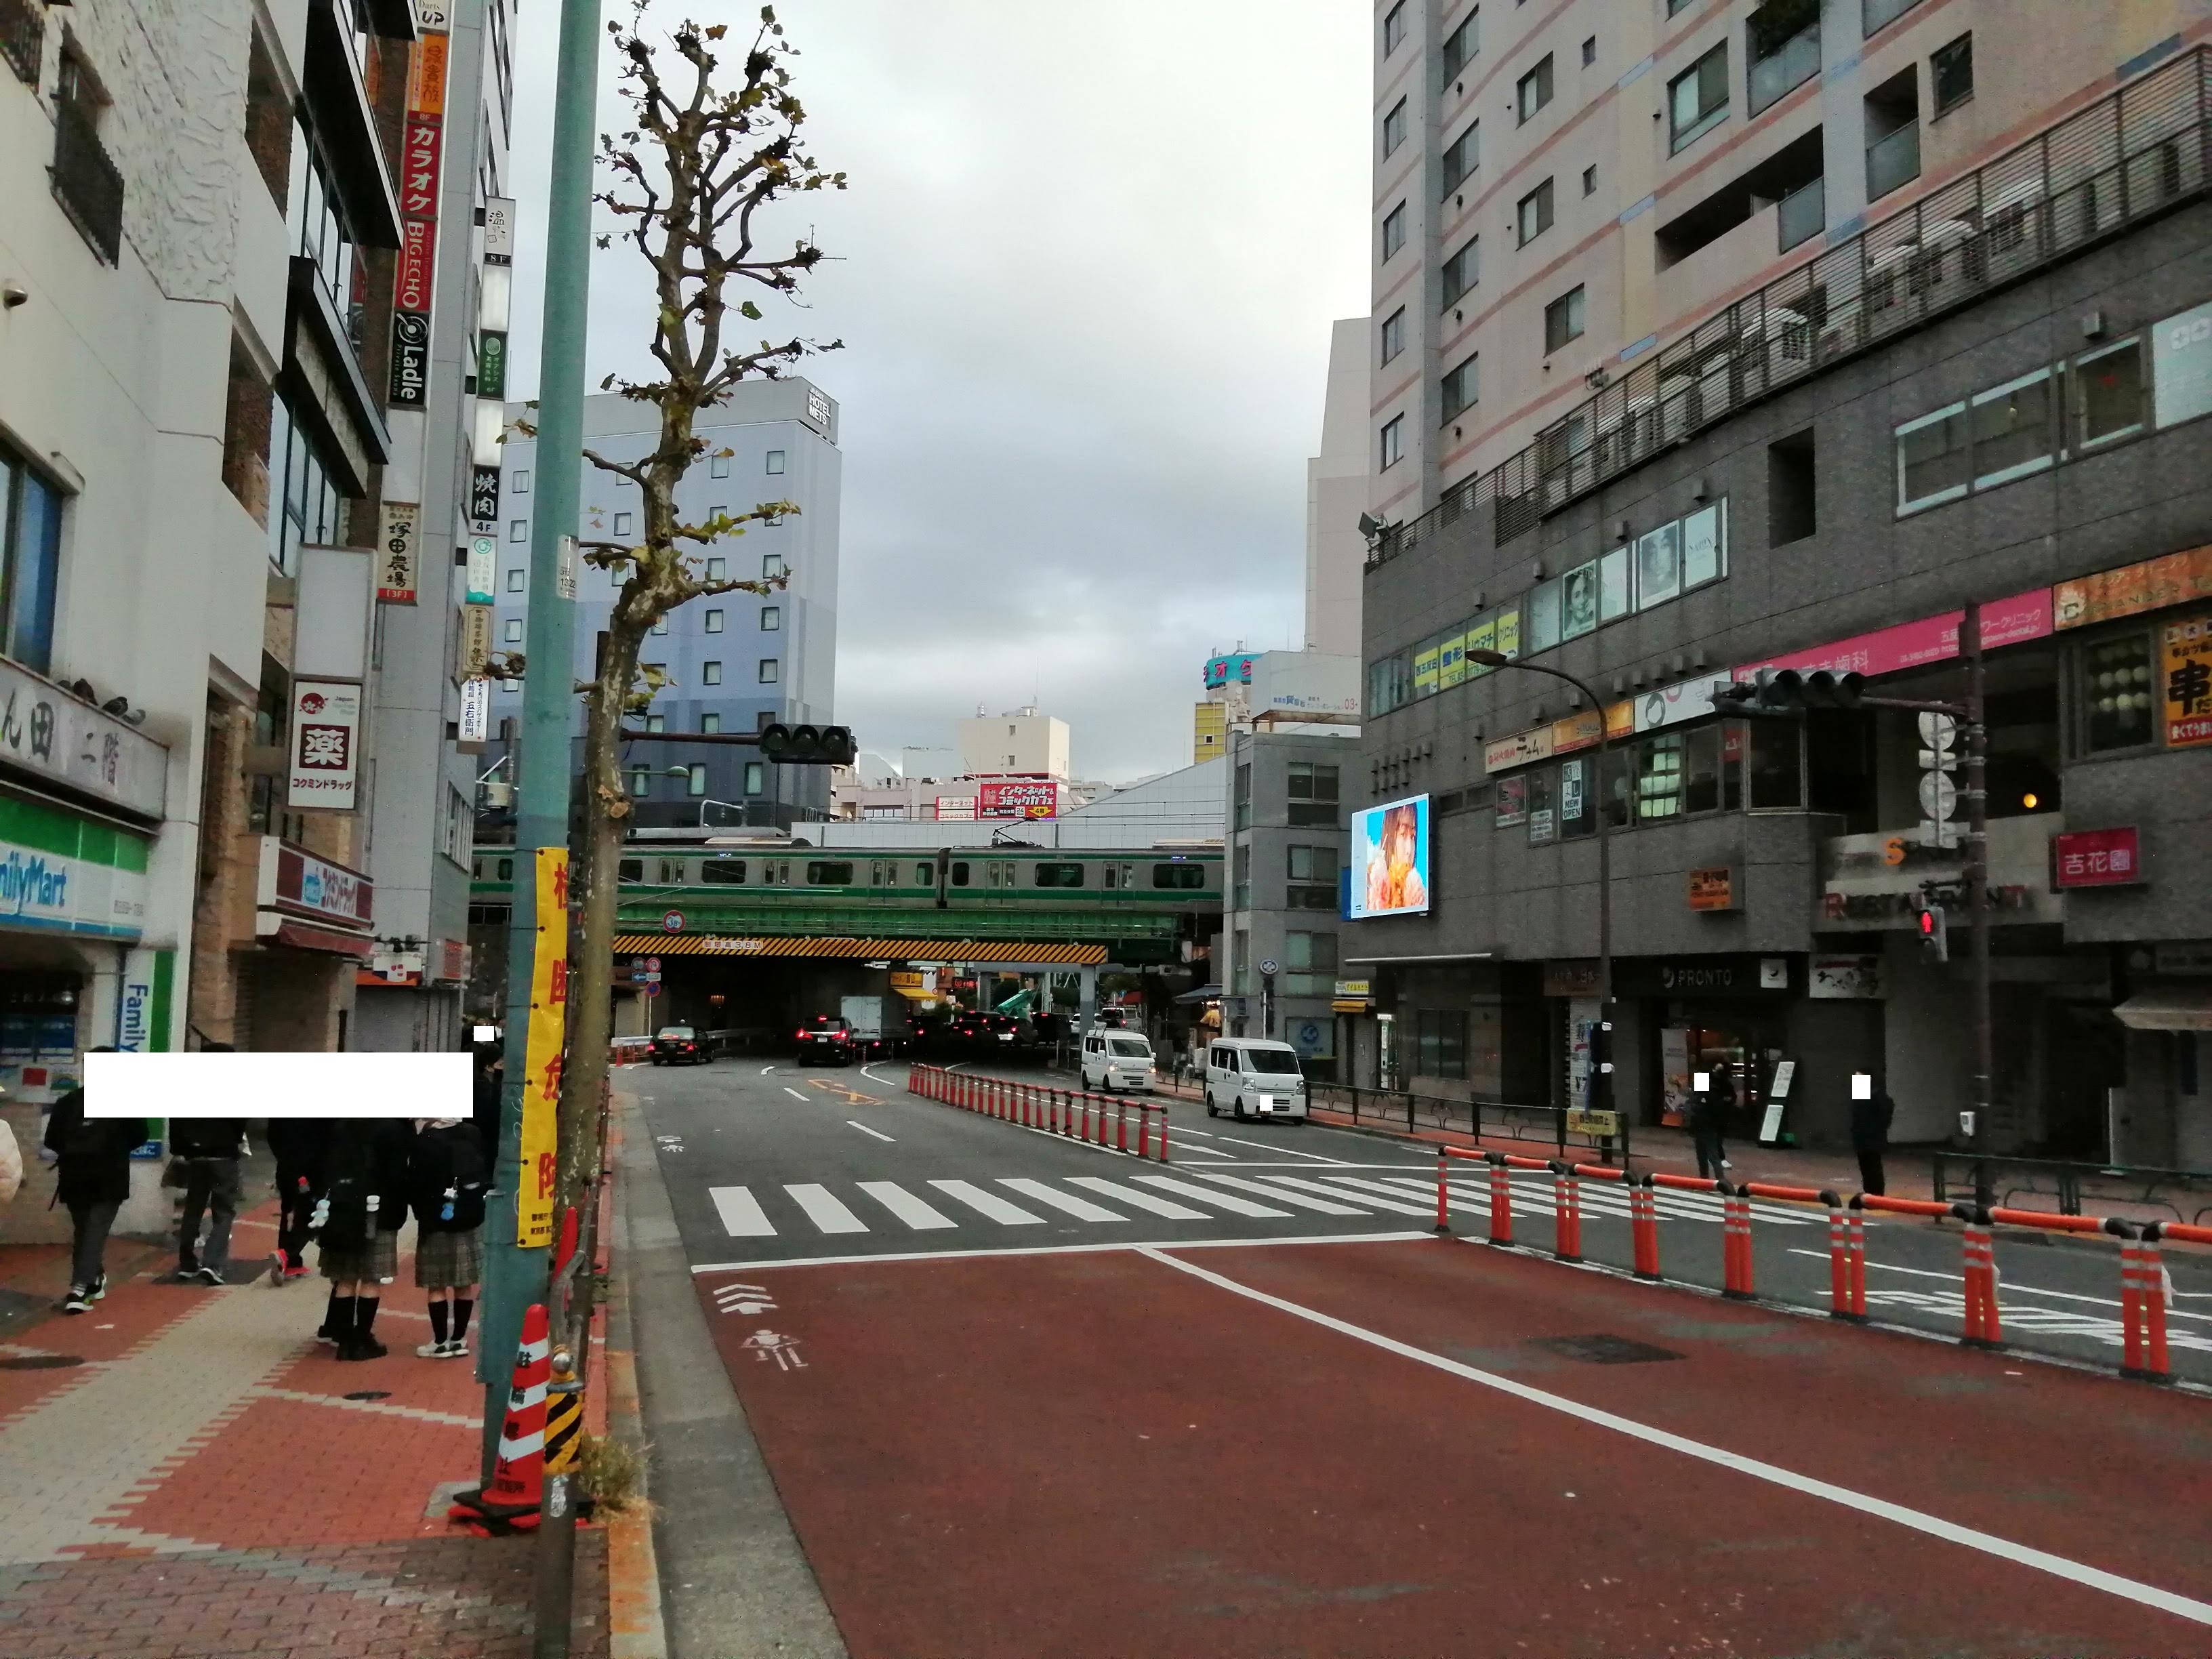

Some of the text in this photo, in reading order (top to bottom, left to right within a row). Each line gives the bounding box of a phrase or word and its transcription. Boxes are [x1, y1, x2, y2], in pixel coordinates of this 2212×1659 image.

[407, 127, 435, 211] カラオケ
[401, 346, 424, 399] Ladle
[809, 404, 827, 425] METS
[810, 393, 831, 417] HOTEL
[475, 473, 497, 516] 焼肉
[476, 522, 491, 532] 4F
[387, 522, 411, 588] 塚田農場
[304, 729, 345, 766] 薬
[293, 779, 352, 791] コクミンドラッグ
[998, 796, 1053, 806] コミックカフェ
[1563, 807, 1580, 819] OPEN
[1565, 800, 1579, 808] NEW
[2065, 849, 2130, 874] 吉花園
[1679, 969, 1732, 987] PRONTO
[125, 984, 148, 1052] Family
